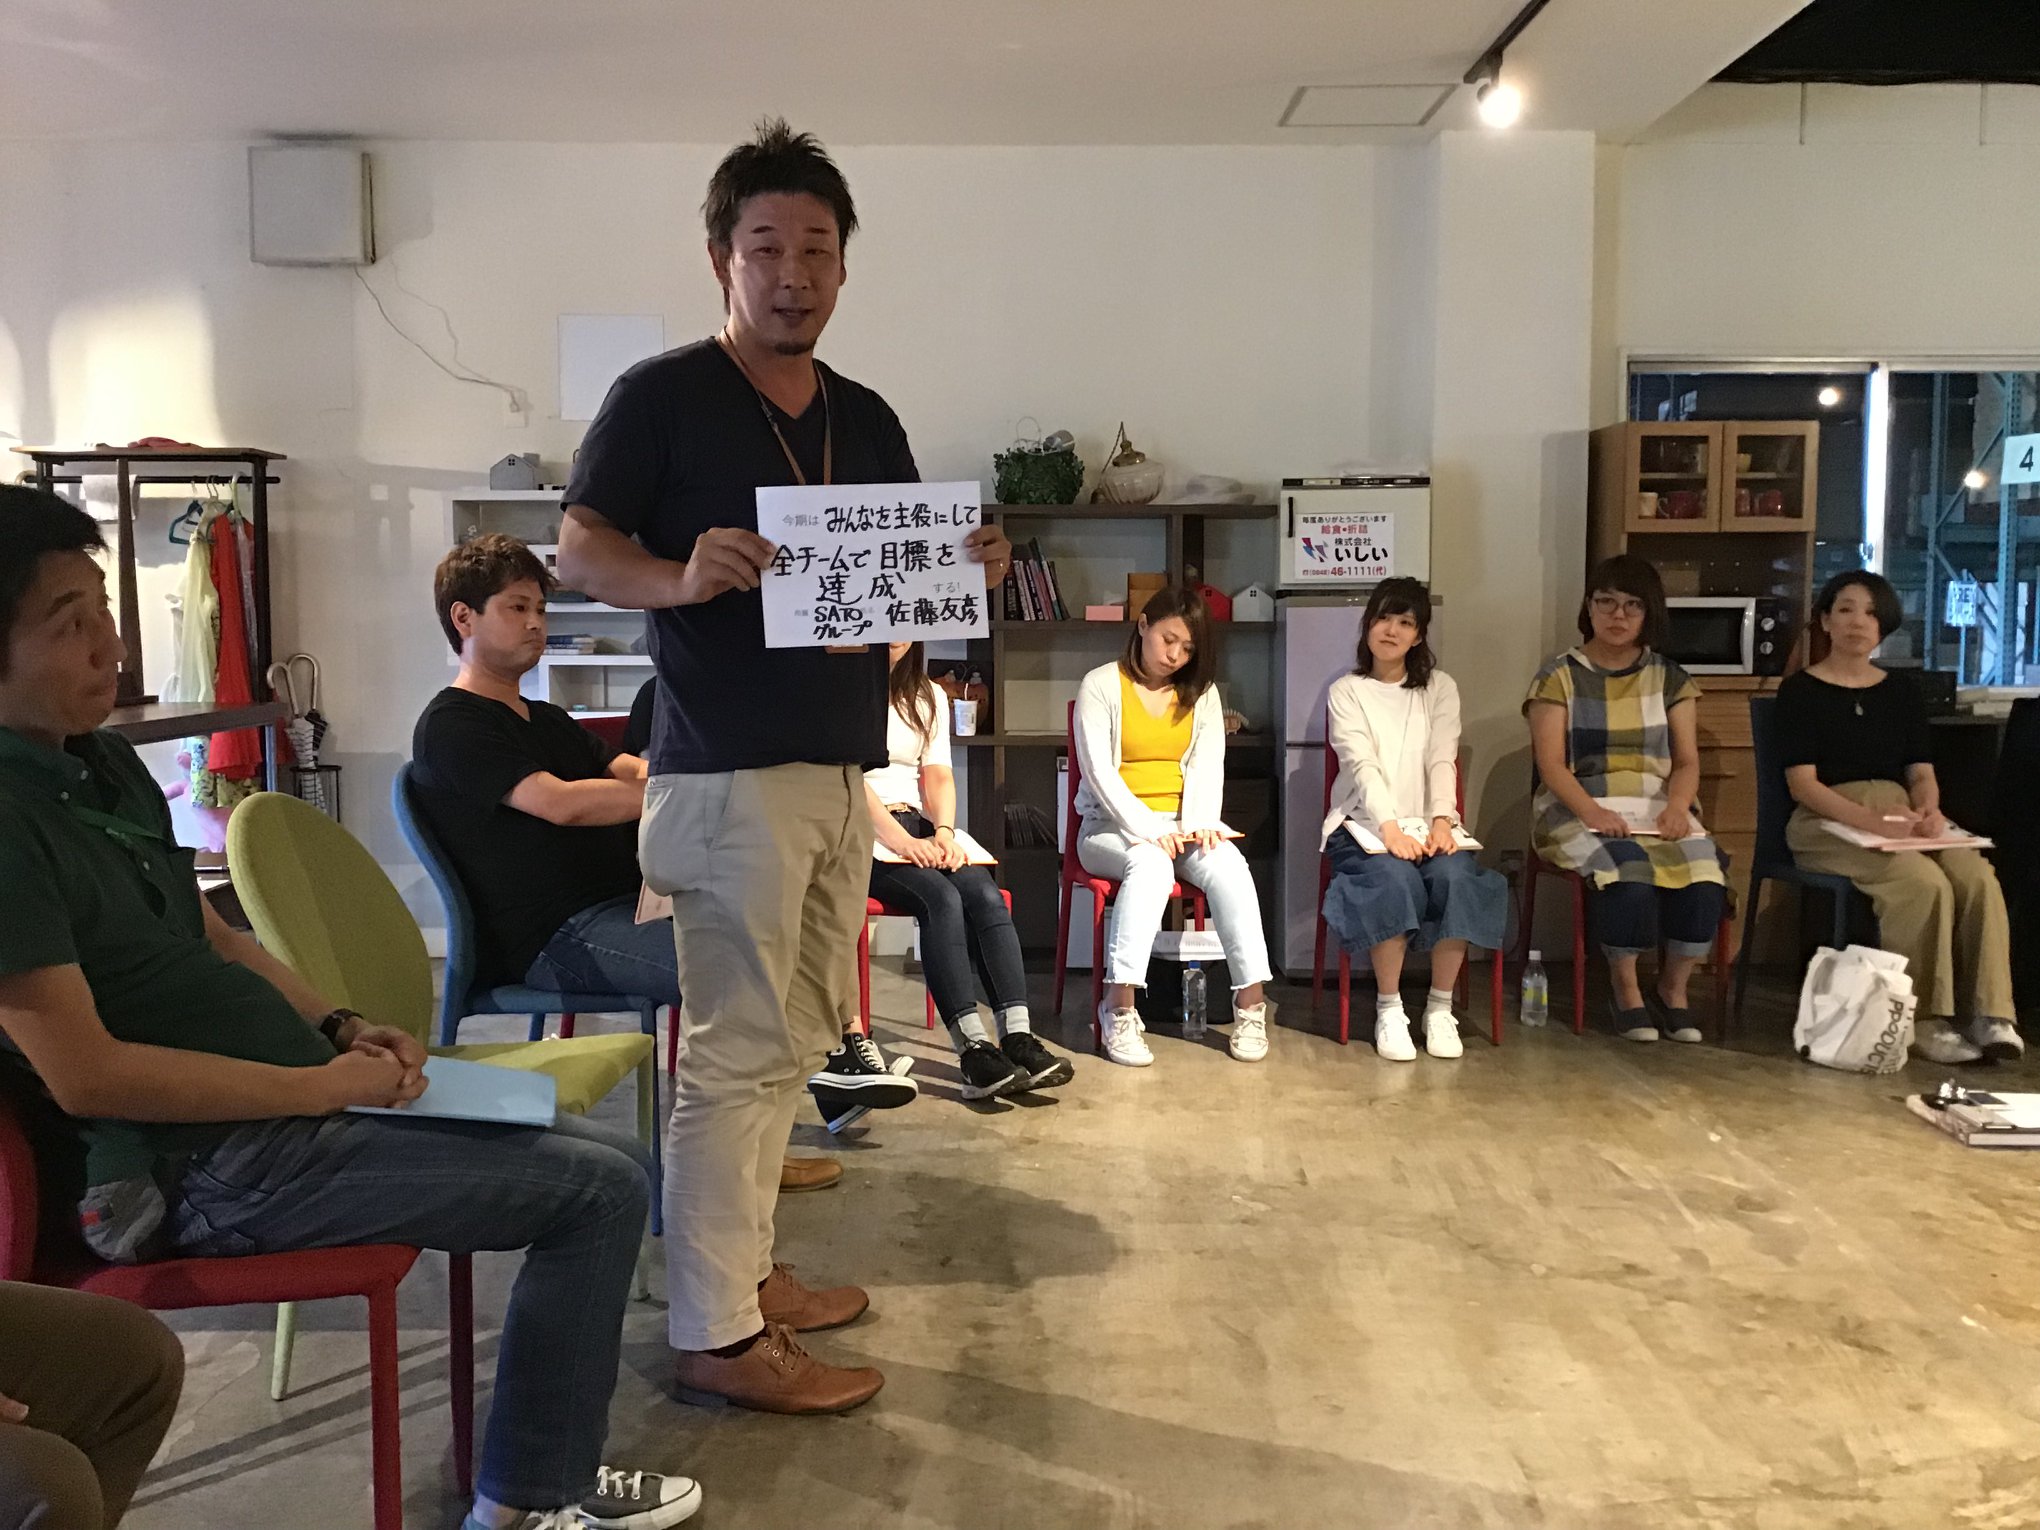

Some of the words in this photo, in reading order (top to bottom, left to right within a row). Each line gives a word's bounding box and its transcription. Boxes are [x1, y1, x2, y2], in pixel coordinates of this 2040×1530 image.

[2019, 445, 2034, 472] 4
[825, 502, 979, 532] みんなを主役にして
[1334, 537, 1372, 547] 株式会社
[1335, 546, 1389, 562] いしい
[814, 605, 863, 622] SATO
[813, 620, 873, 640] グループ
